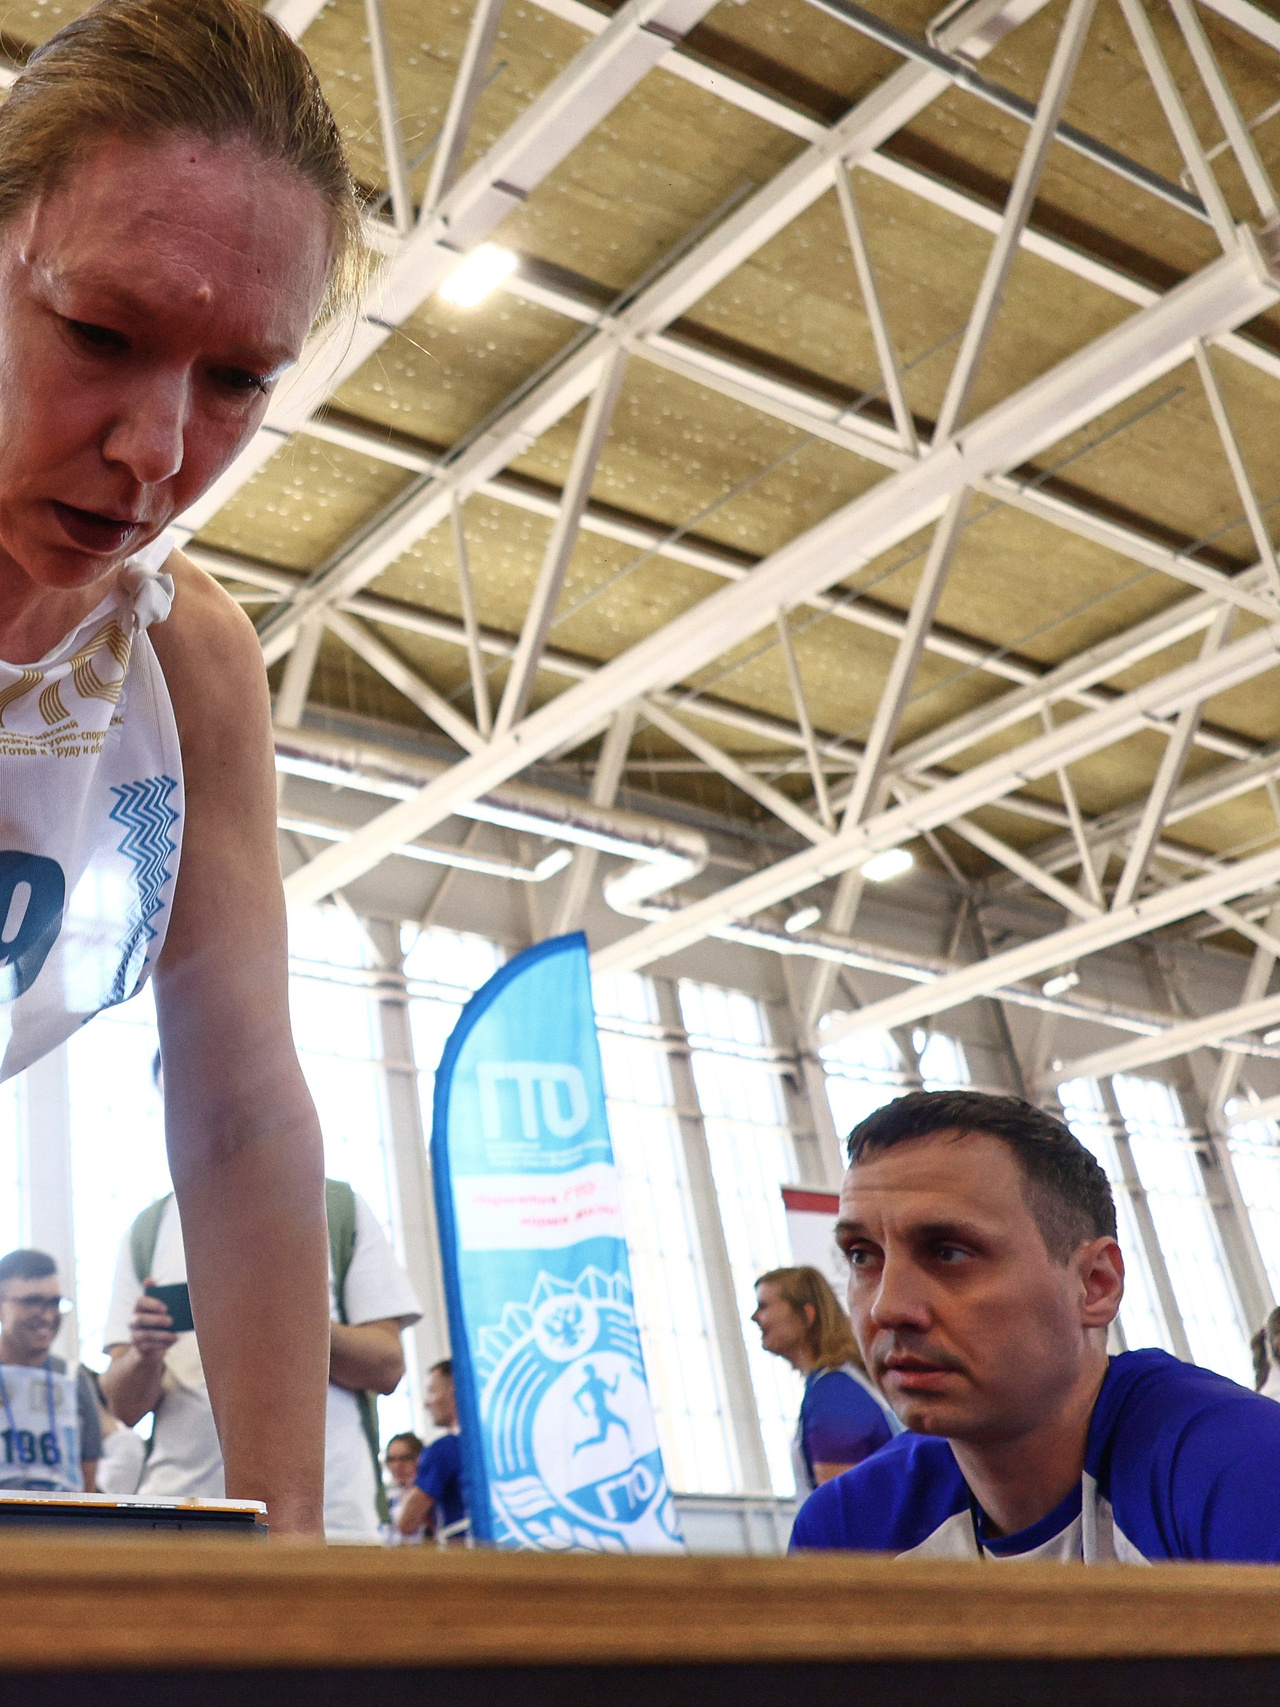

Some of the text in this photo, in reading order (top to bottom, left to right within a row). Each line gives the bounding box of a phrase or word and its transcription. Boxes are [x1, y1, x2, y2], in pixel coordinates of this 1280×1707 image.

[83, 745, 89, 754] и
[477, 1061, 589, 1140] ГТО
[595, 1463, 655, 1520] ГТО
